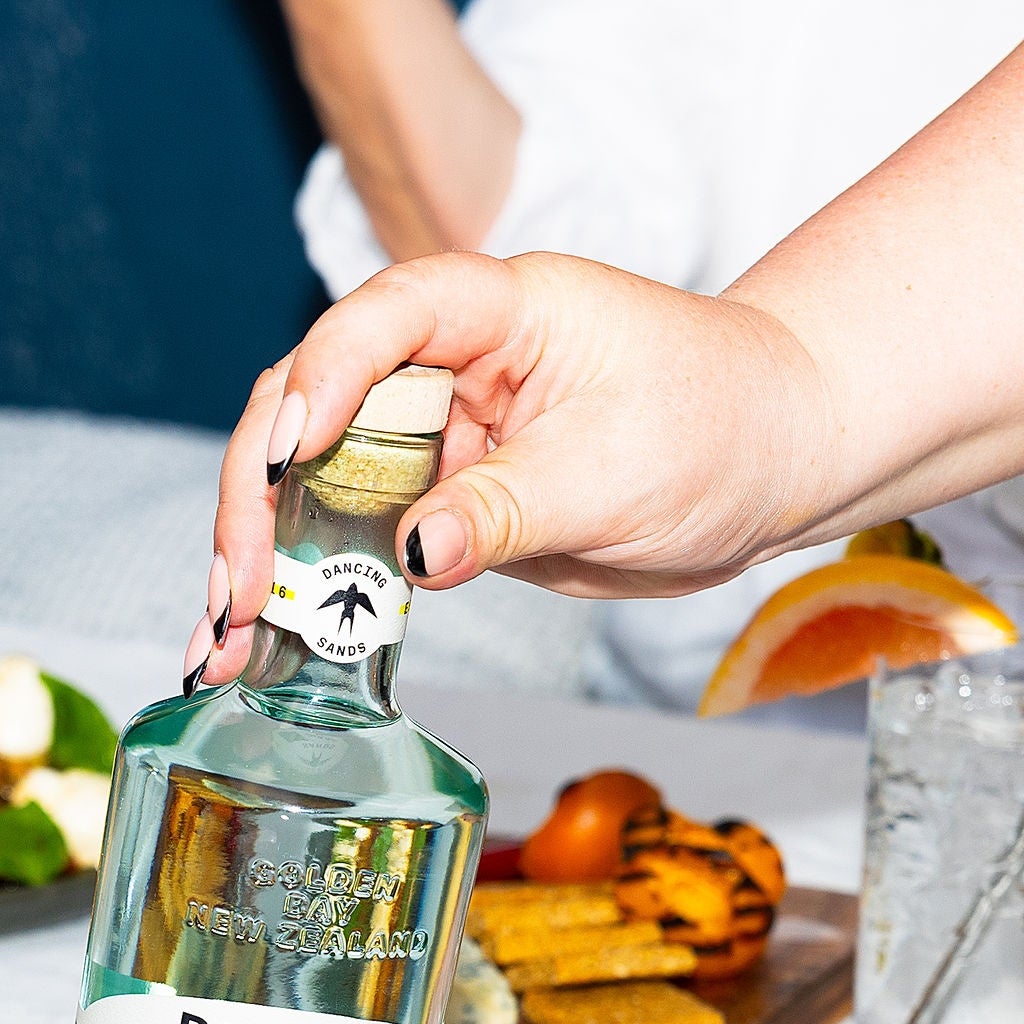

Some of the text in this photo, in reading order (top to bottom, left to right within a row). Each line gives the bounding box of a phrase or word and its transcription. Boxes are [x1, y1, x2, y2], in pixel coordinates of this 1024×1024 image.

[322, 562, 387, 589] DANCING
[317, 637, 366, 657] SANDS
[249, 858, 401, 902] GOLDEN
[282, 890, 360, 927] BAY
[186, 901, 429, 961] NEW ZEALAND
